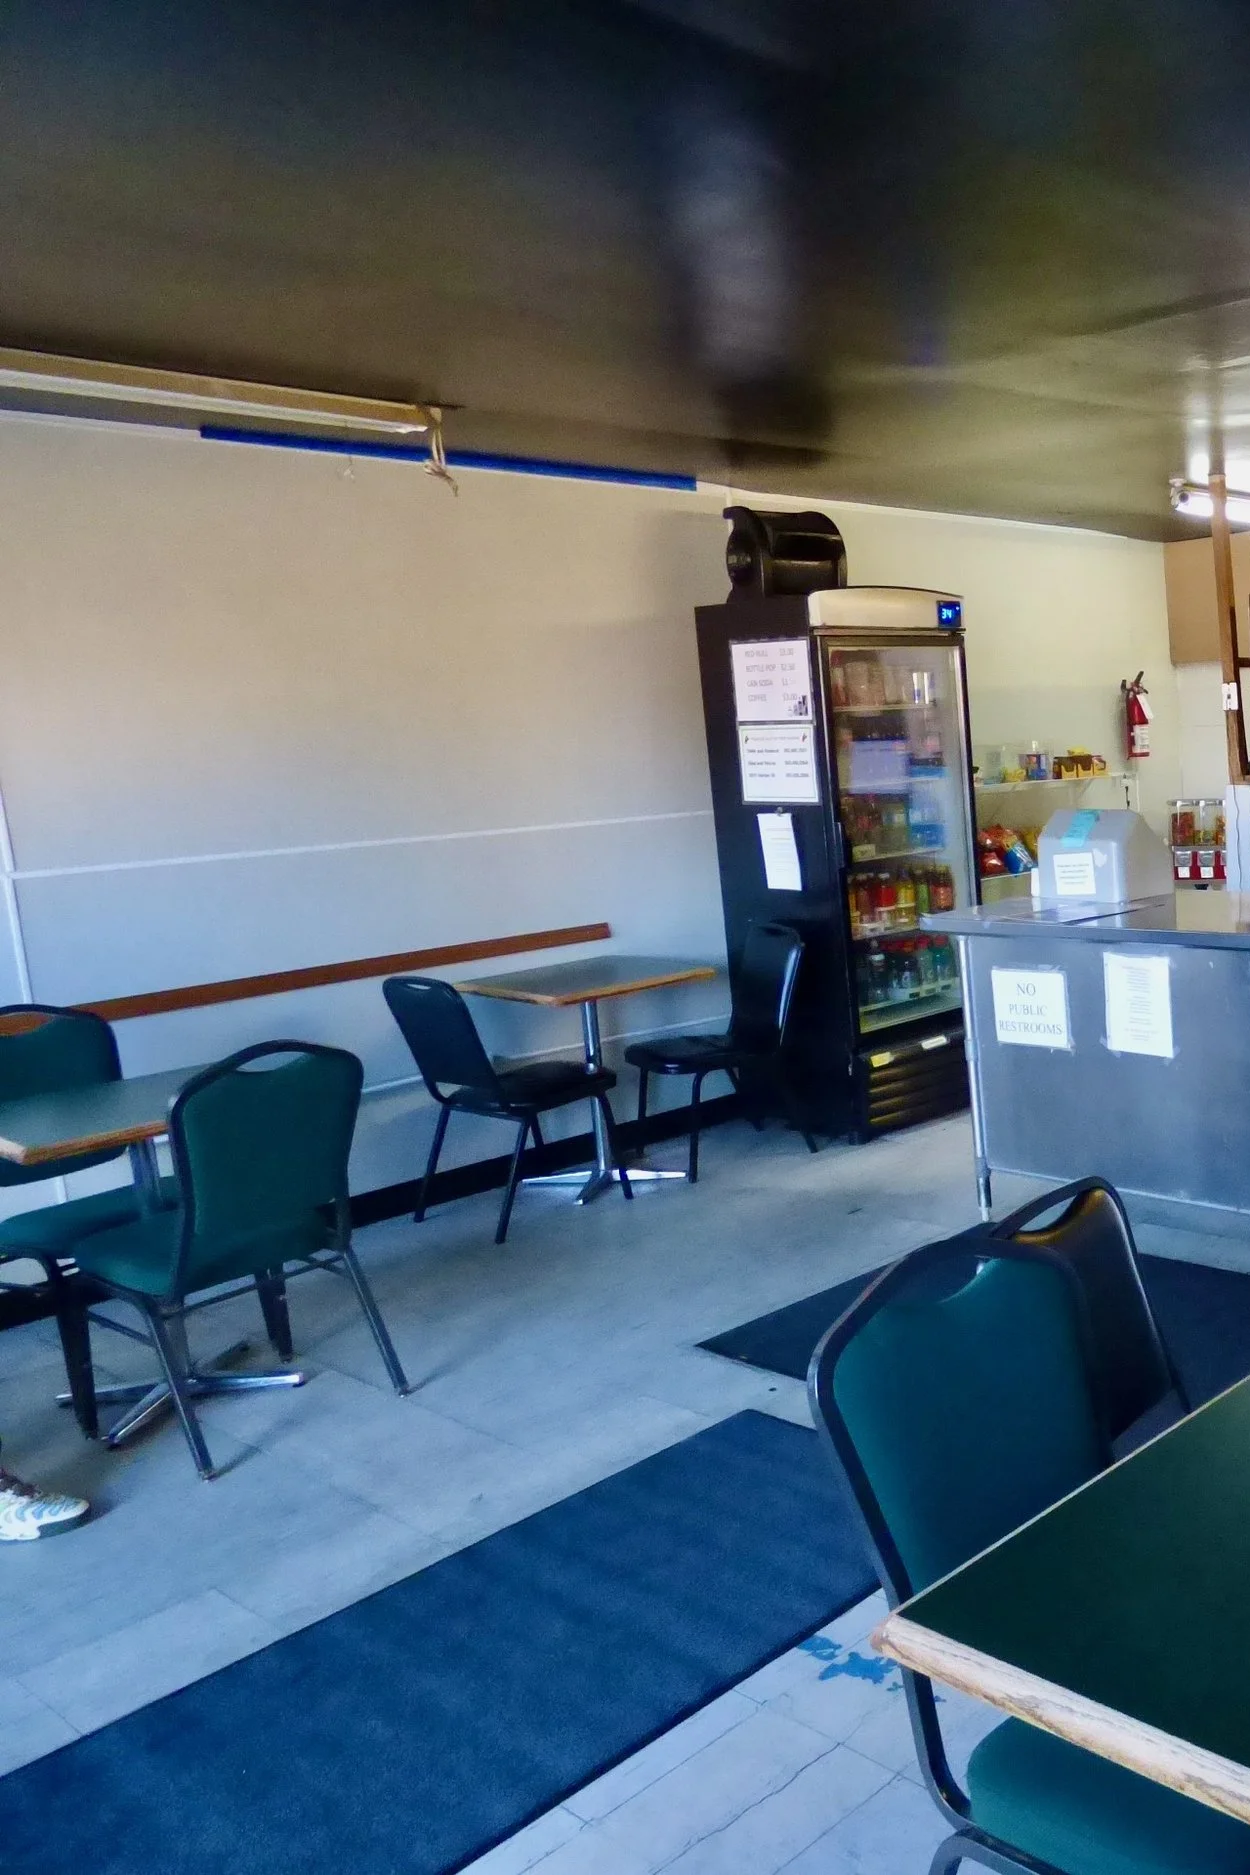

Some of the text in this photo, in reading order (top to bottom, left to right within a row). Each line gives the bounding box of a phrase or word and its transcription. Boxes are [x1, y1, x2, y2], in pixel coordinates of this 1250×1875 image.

[941, 607, 952, 619] 34
[1016, 983, 1036, 996] NO
[1008, 1003, 1048, 1016] PUBLIC
[999, 1020, 1063, 1035] RESTROOMS
